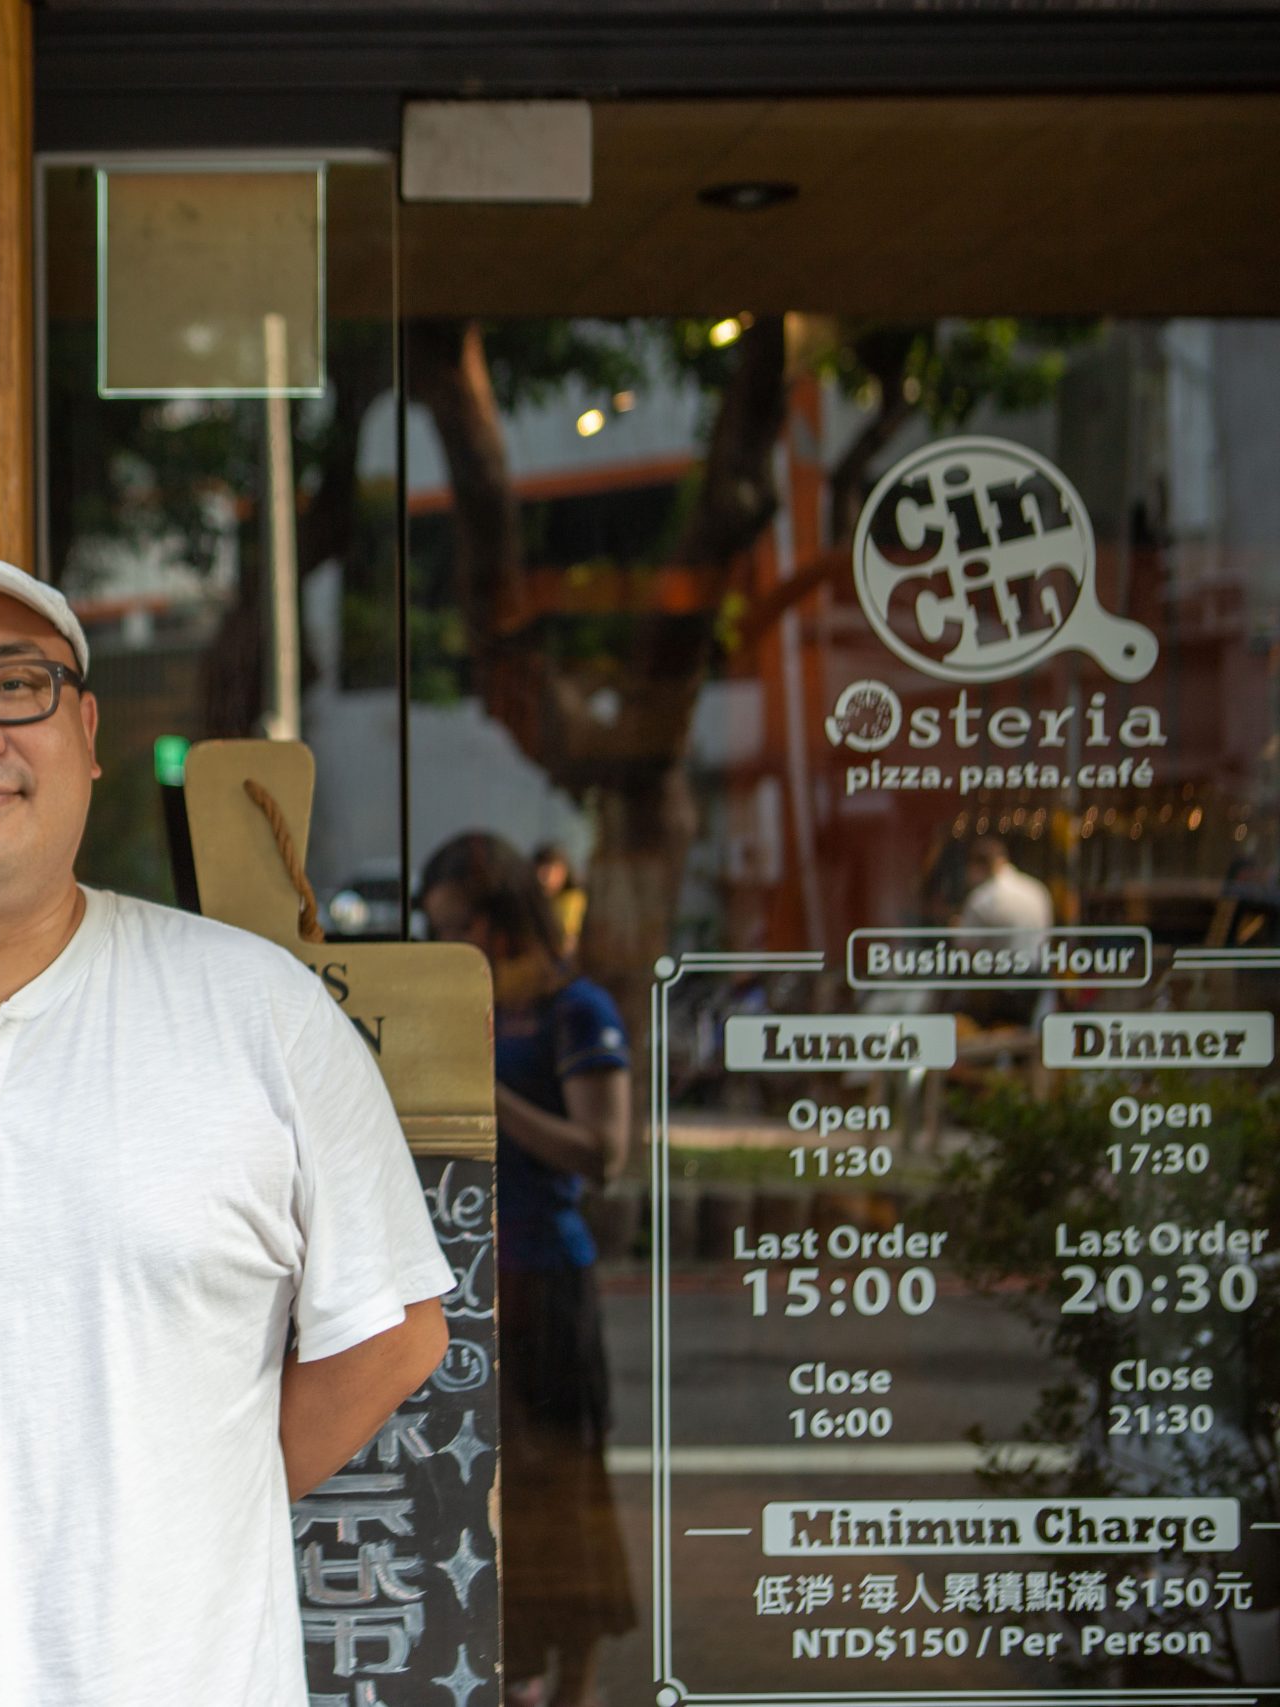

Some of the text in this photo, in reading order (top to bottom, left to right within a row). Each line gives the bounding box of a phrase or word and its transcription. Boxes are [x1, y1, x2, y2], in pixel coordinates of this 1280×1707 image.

[824, 679, 1168, 752] Osteria
[867, 940, 1136, 975] Business Hour
[762, 1022, 920, 1063] Lunch
[1071, 1022, 1247, 1061] Dinner
[787, 1099, 891, 1137] Open
[1108, 1096, 1212, 1135] Open
[788, 1145, 893, 1178] 11:30
[1105, 1142, 1211, 1175] 17:30
[733, 1223, 948, 1261] Last Order
[1055, 1221, 1270, 1258] Last Order
[741, 1266, 937, 1317] 15:00
[1060, 1263, 1259, 1314] 20:30
[787, 1361, 893, 1396] Close
[1109, 1358, 1214, 1393] Close
[788, 1406, 893, 1439] 16:00
[1107, 1403, 1214, 1436] 21:30
[790, 1506, 1218, 1553] Minimun Charge
[792, 1624, 970, 1661] NTD$150
[999, 1625, 1063, 1657] Per
[1081, 1624, 1212, 1656] Person
